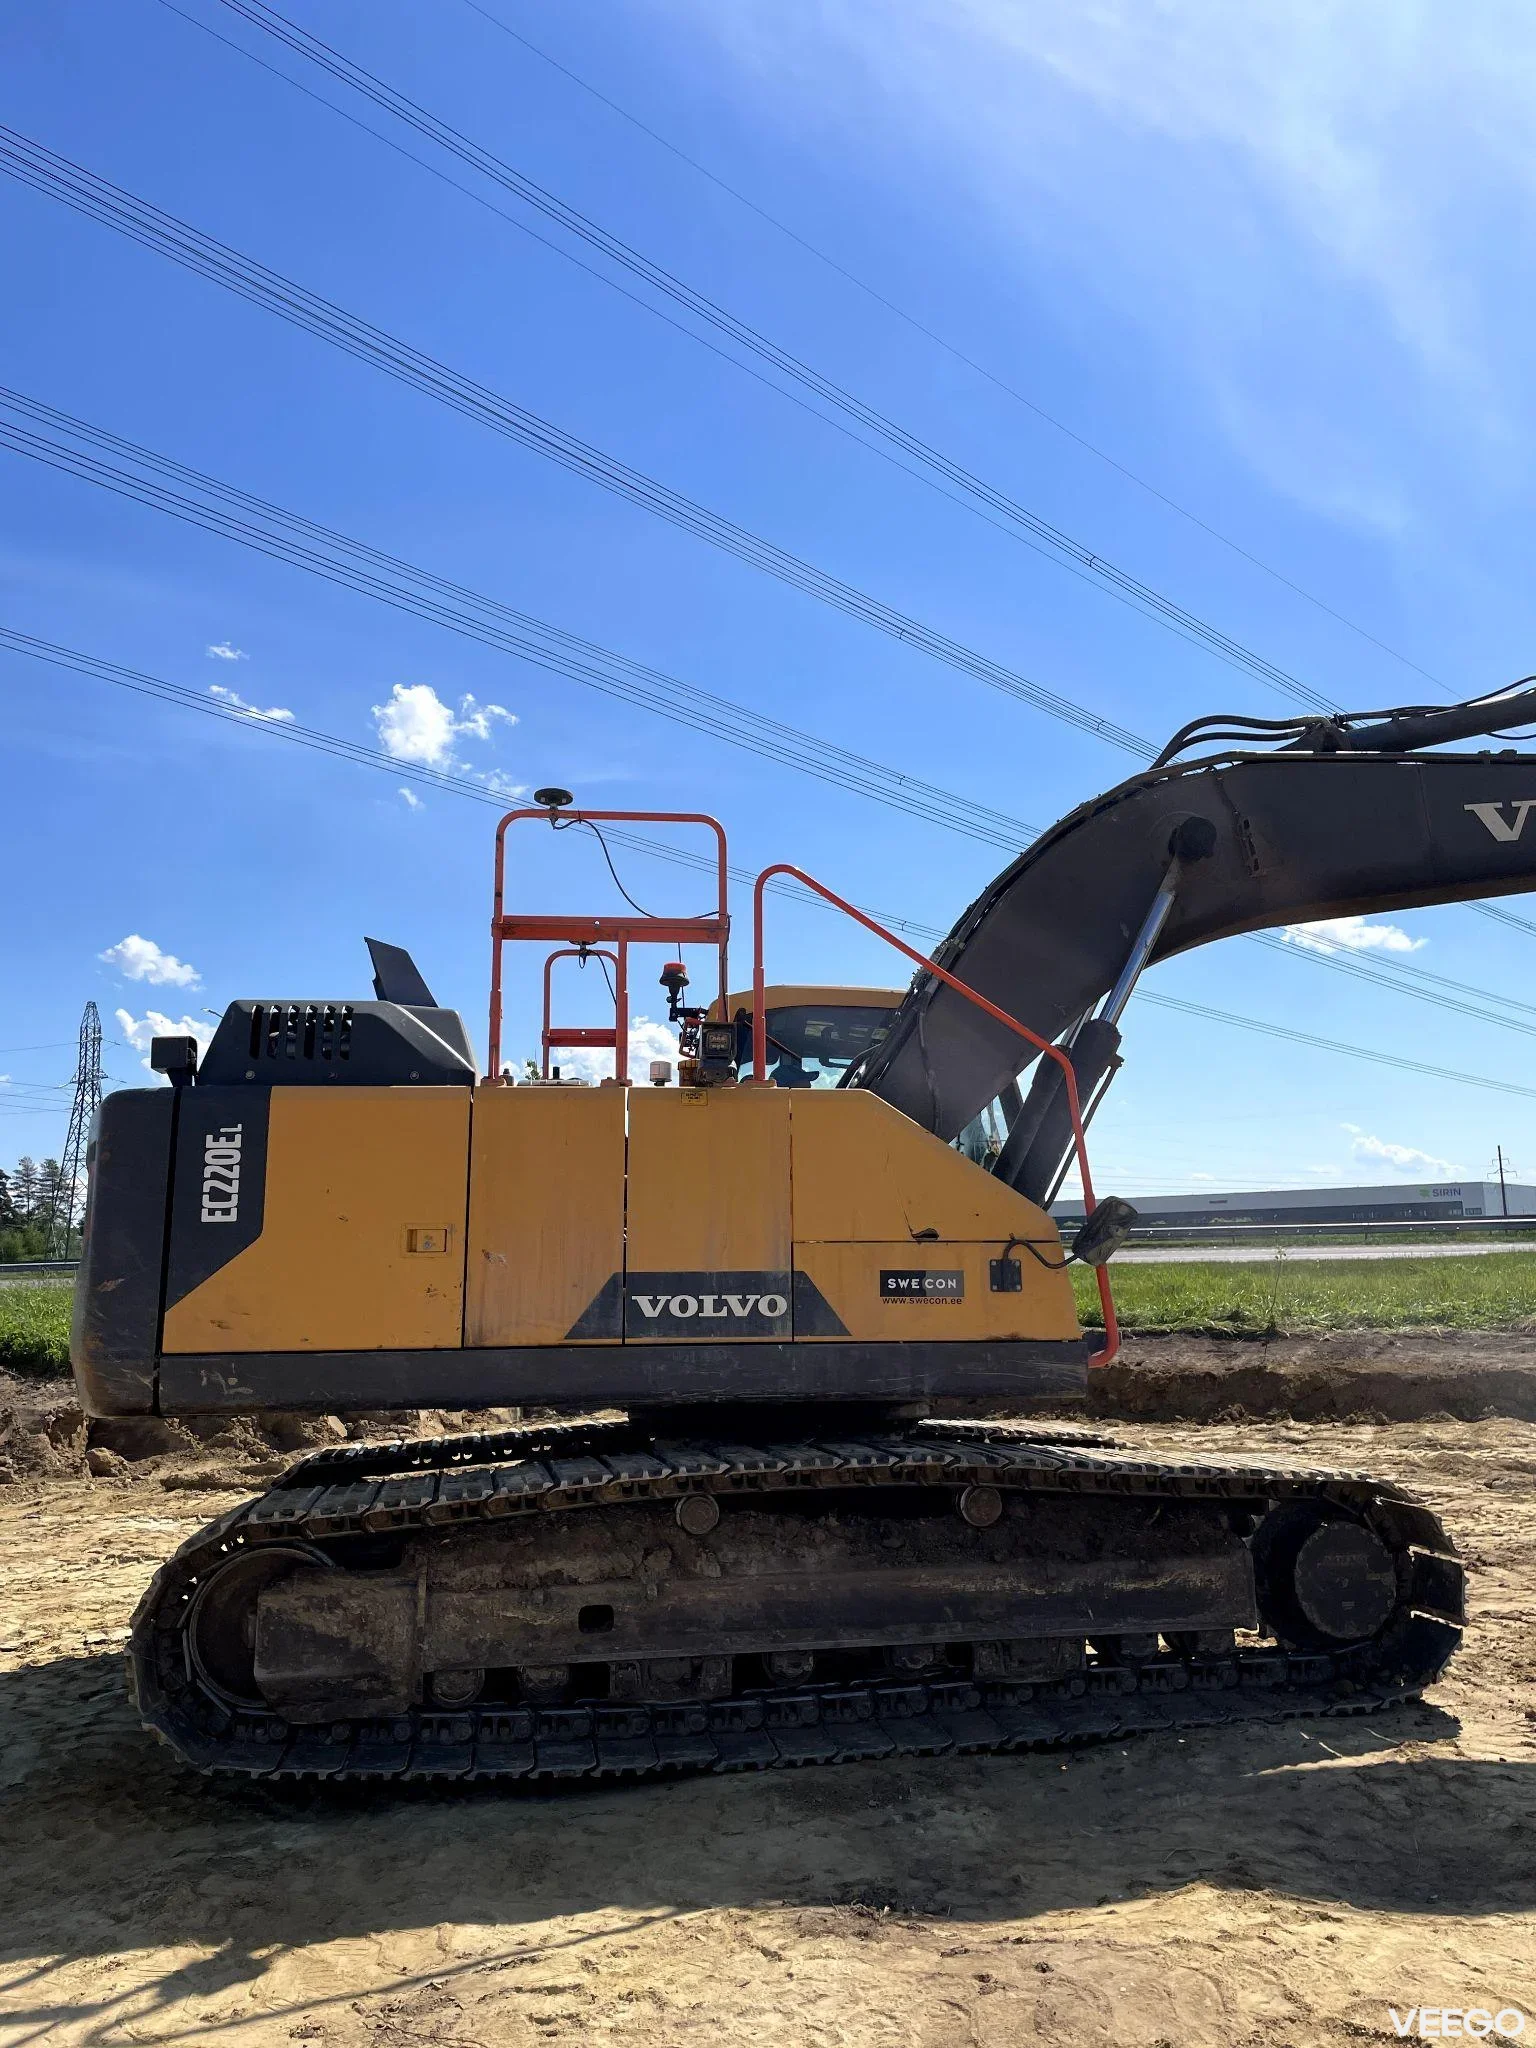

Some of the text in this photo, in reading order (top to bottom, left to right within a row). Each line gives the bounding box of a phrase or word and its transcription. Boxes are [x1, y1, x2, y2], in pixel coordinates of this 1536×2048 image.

[1432, 1187, 1461, 1198] SIRIN
[631, 1294, 788, 1318] VOLVO
[882, 1297, 962, 1305] www.swecon.ee
